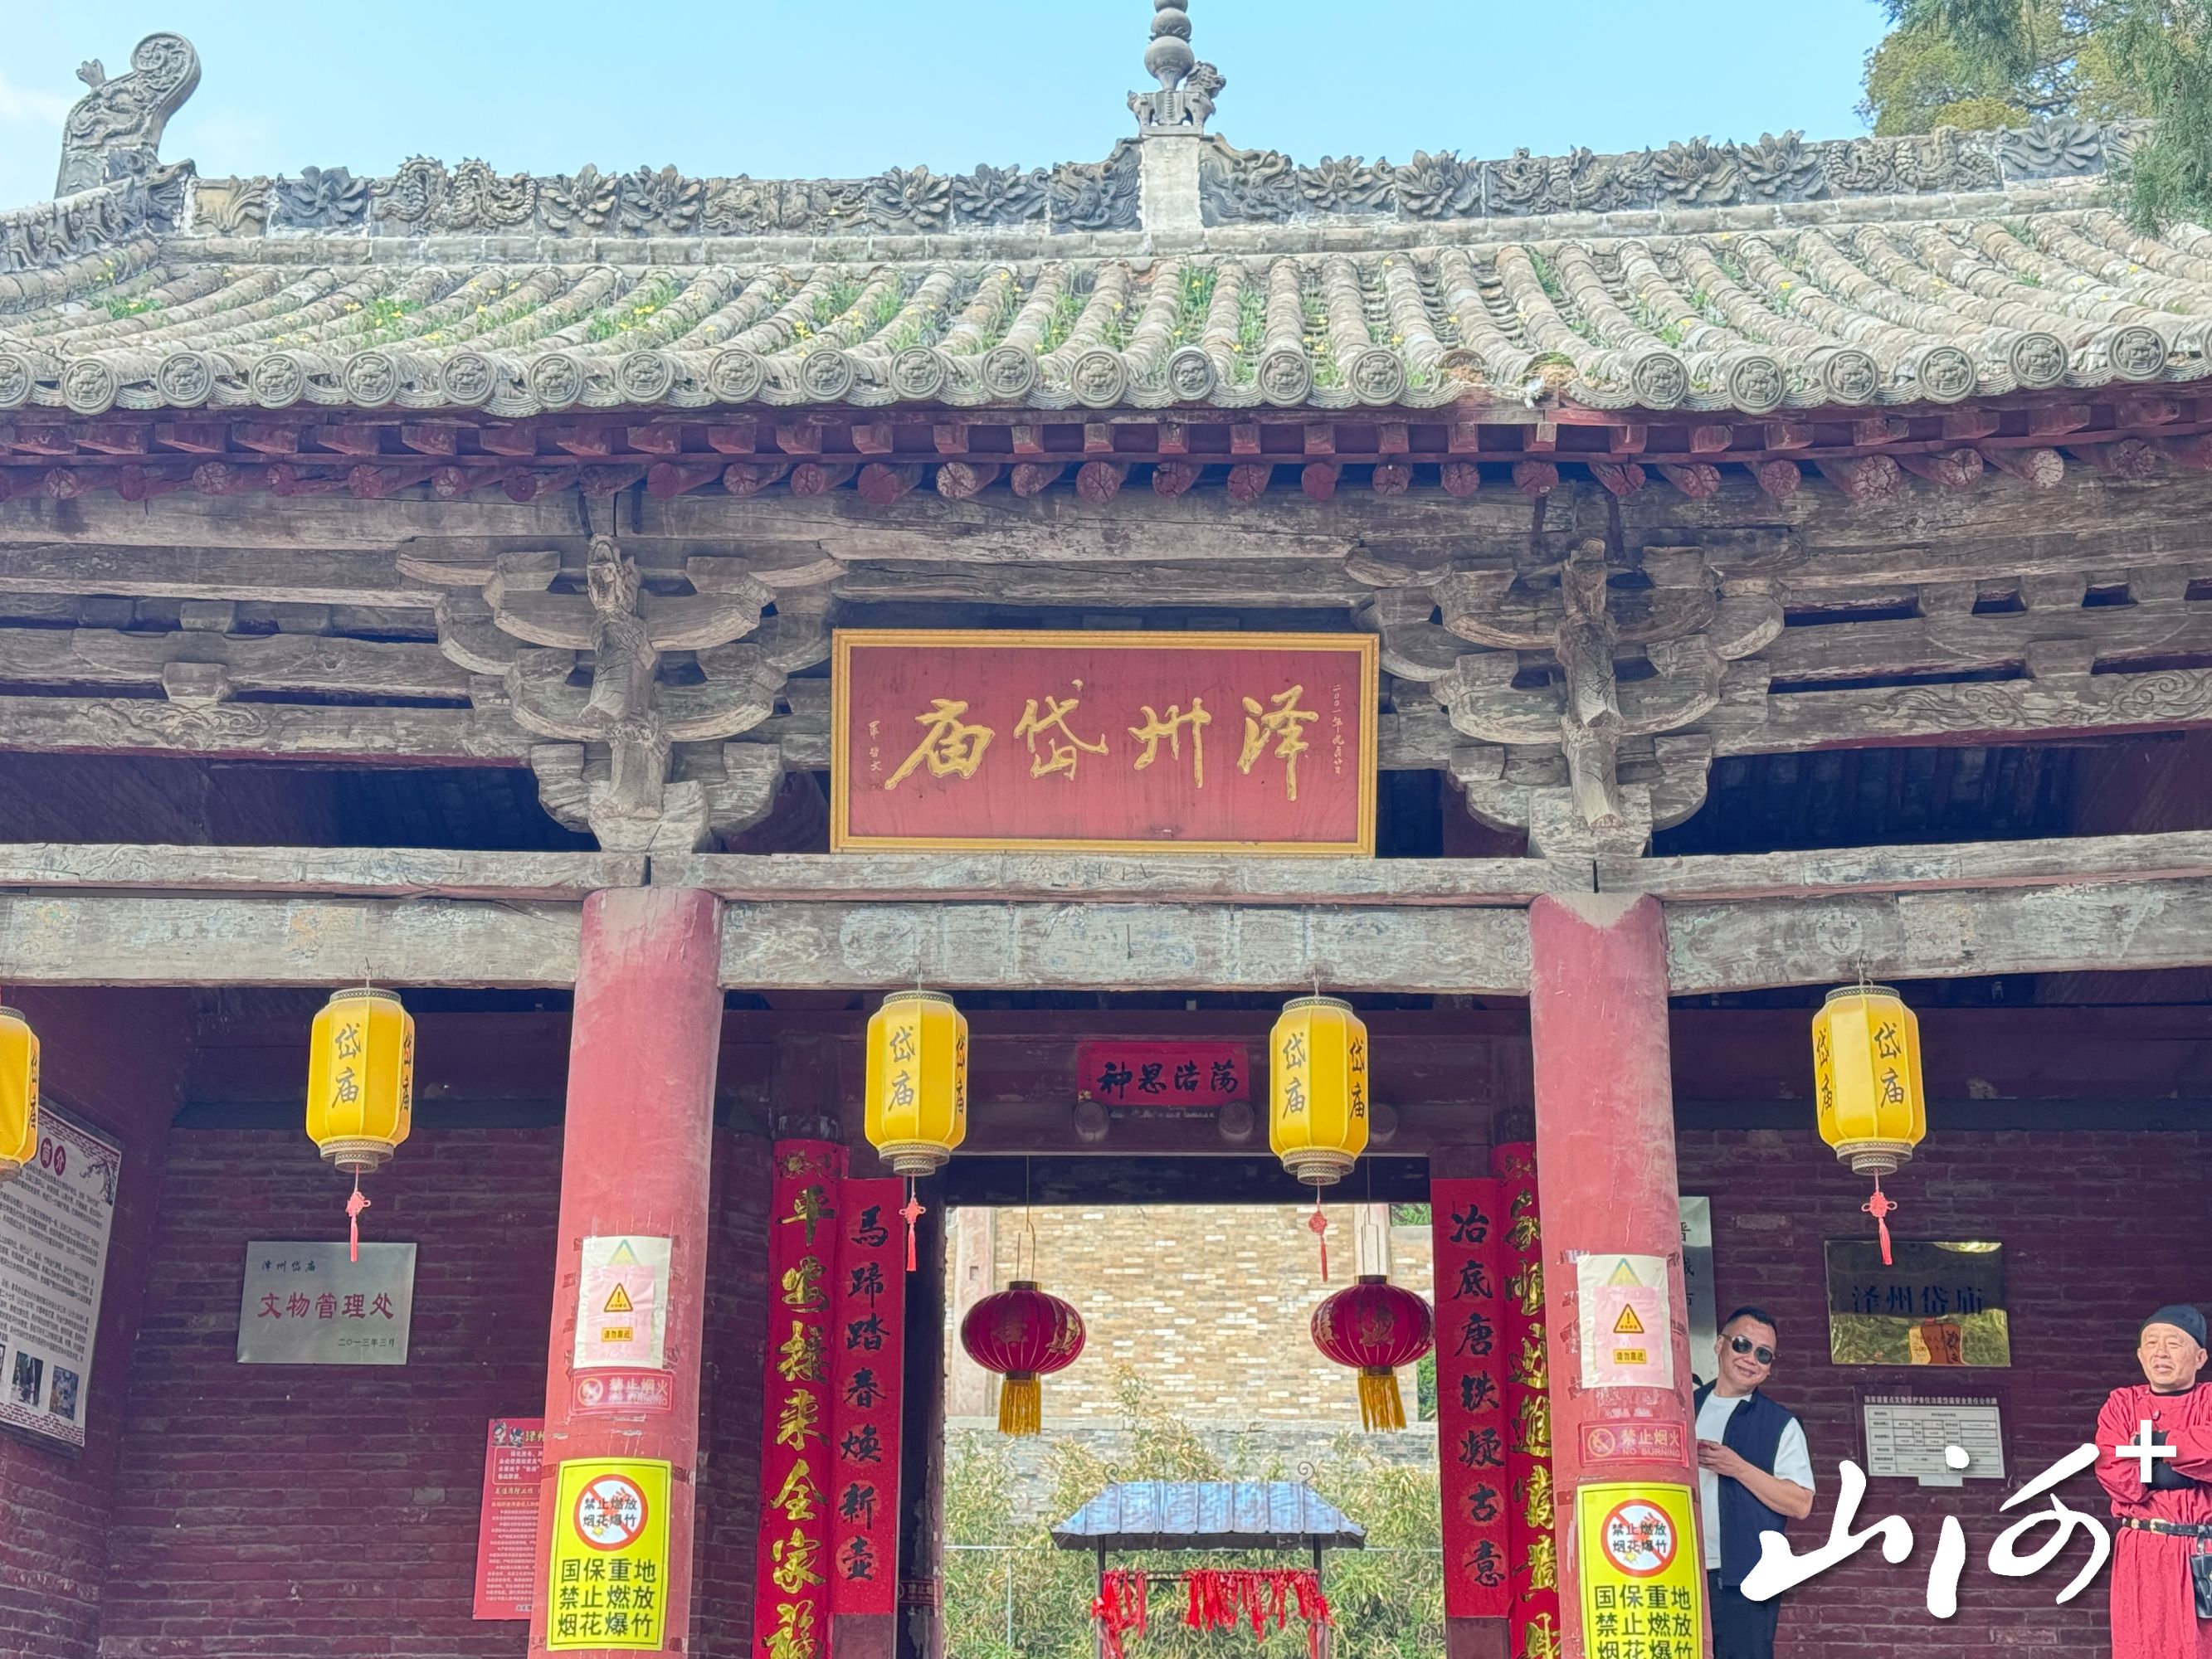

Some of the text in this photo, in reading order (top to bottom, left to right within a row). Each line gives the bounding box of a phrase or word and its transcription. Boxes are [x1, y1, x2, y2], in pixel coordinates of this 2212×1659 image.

[884, 679, 1318, 802] 泽州岱庙
[331, 1022, 361, 1109] 岱庙
[888, 1025, 916, 1112] 岱庙
[1282, 1032, 1307, 1120] 岱庙
[1349, 1036, 1366, 1120] 岱庙
[1815, 1027, 1834, 1118] 岱庙
[1873, 1021, 1905, 1109] 岱庙
[256, 1292, 395, 1320] 文物管理处
[1851, 1285, 1984, 1315] 泽州岱庙
[609, 1377, 668, 1397] 禁止烟火
[1621, 1428, 1680, 1447] 禁止烟火
[1621, 1447, 1681, 1457] NO BURNING
[584, 1497, 637, 1511] 禁止燃放
[582, 1514, 636, 1528] 烟花爆竹
[1612, 1522, 1667, 1537] 禁止燃放
[1612, 1540, 1667, 1554] 烟花爆竹
[560, 1557, 657, 1584] 国保重地
[558, 1584, 655, 1611] 禁止燃放
[1594, 1584, 1692, 1611] 国保重地
[557, 1612, 654, 1638] 烟花爆竹
[1596, 1612, 1693, 1638] 禁止燃放
